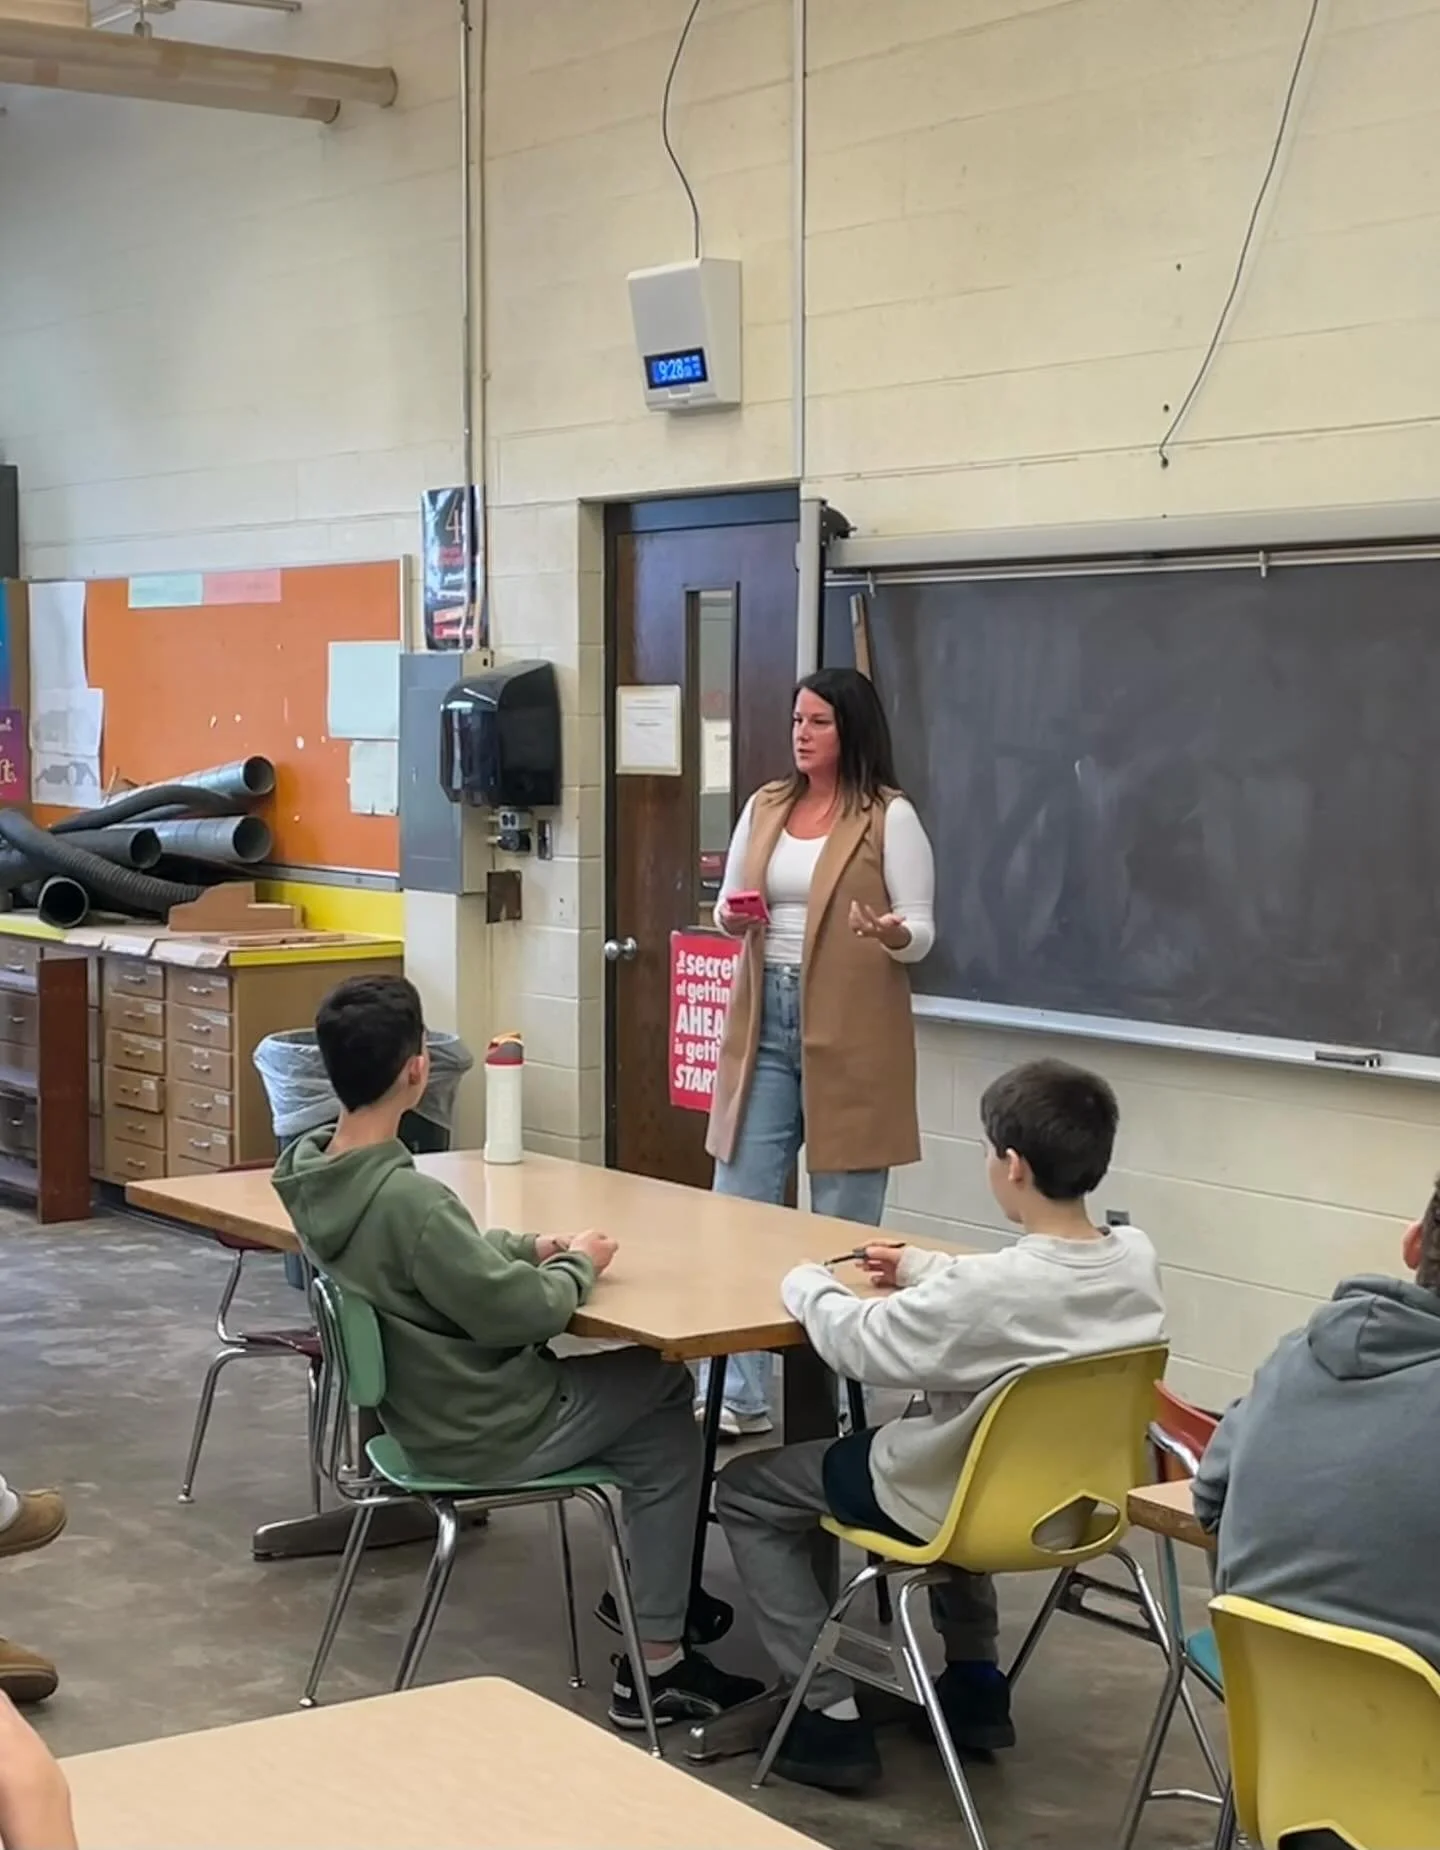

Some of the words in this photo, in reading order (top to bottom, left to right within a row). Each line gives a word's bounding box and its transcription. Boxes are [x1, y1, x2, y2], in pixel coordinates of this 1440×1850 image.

[687, 980, 730, 1004] gettin
[675, 1003, 725, 1038] AHEA
[674, 1064, 717, 1094] STAR
